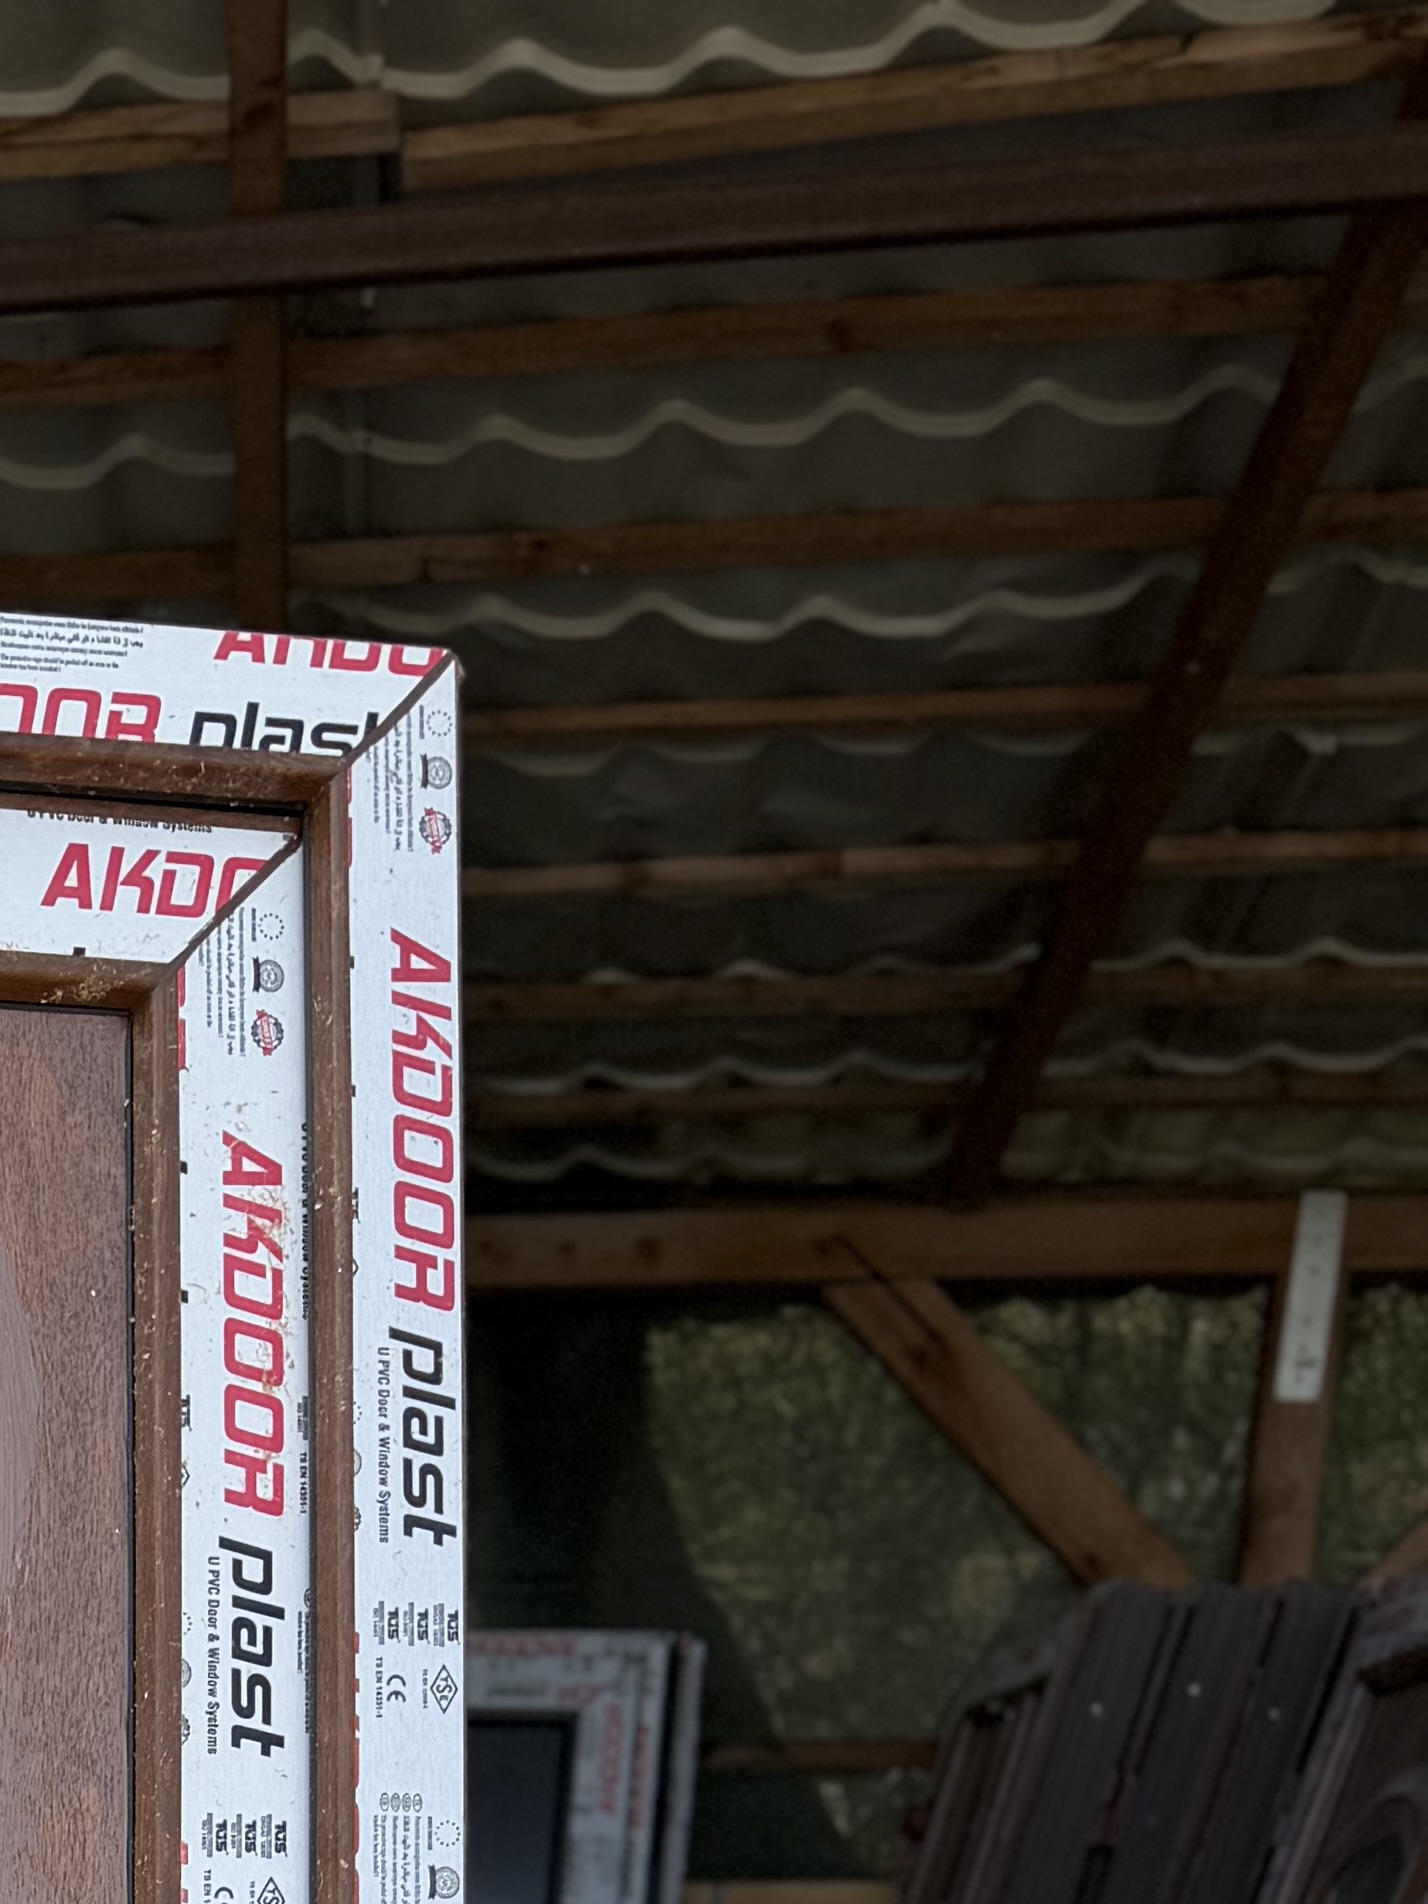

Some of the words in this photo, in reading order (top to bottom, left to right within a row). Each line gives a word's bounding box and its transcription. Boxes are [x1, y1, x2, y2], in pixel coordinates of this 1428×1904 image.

[390, 930, 455, 1312] AKDOOR
[222, 1133, 284, 1517] AKDOOR
[386, 1325, 458, 1547] plast
[207, 1556, 220, 1566] U
[208, 1569, 221, 1596] PVC
[207, 1598, 220, 1630] Door
[207, 1633, 220, 1643] &
[216, 1535, 286, 1758] plast
[207, 1647, 220, 1698] Window
[387, 1675, 406, 1702] CE
[204, 1701, 220, 1755] Systems
